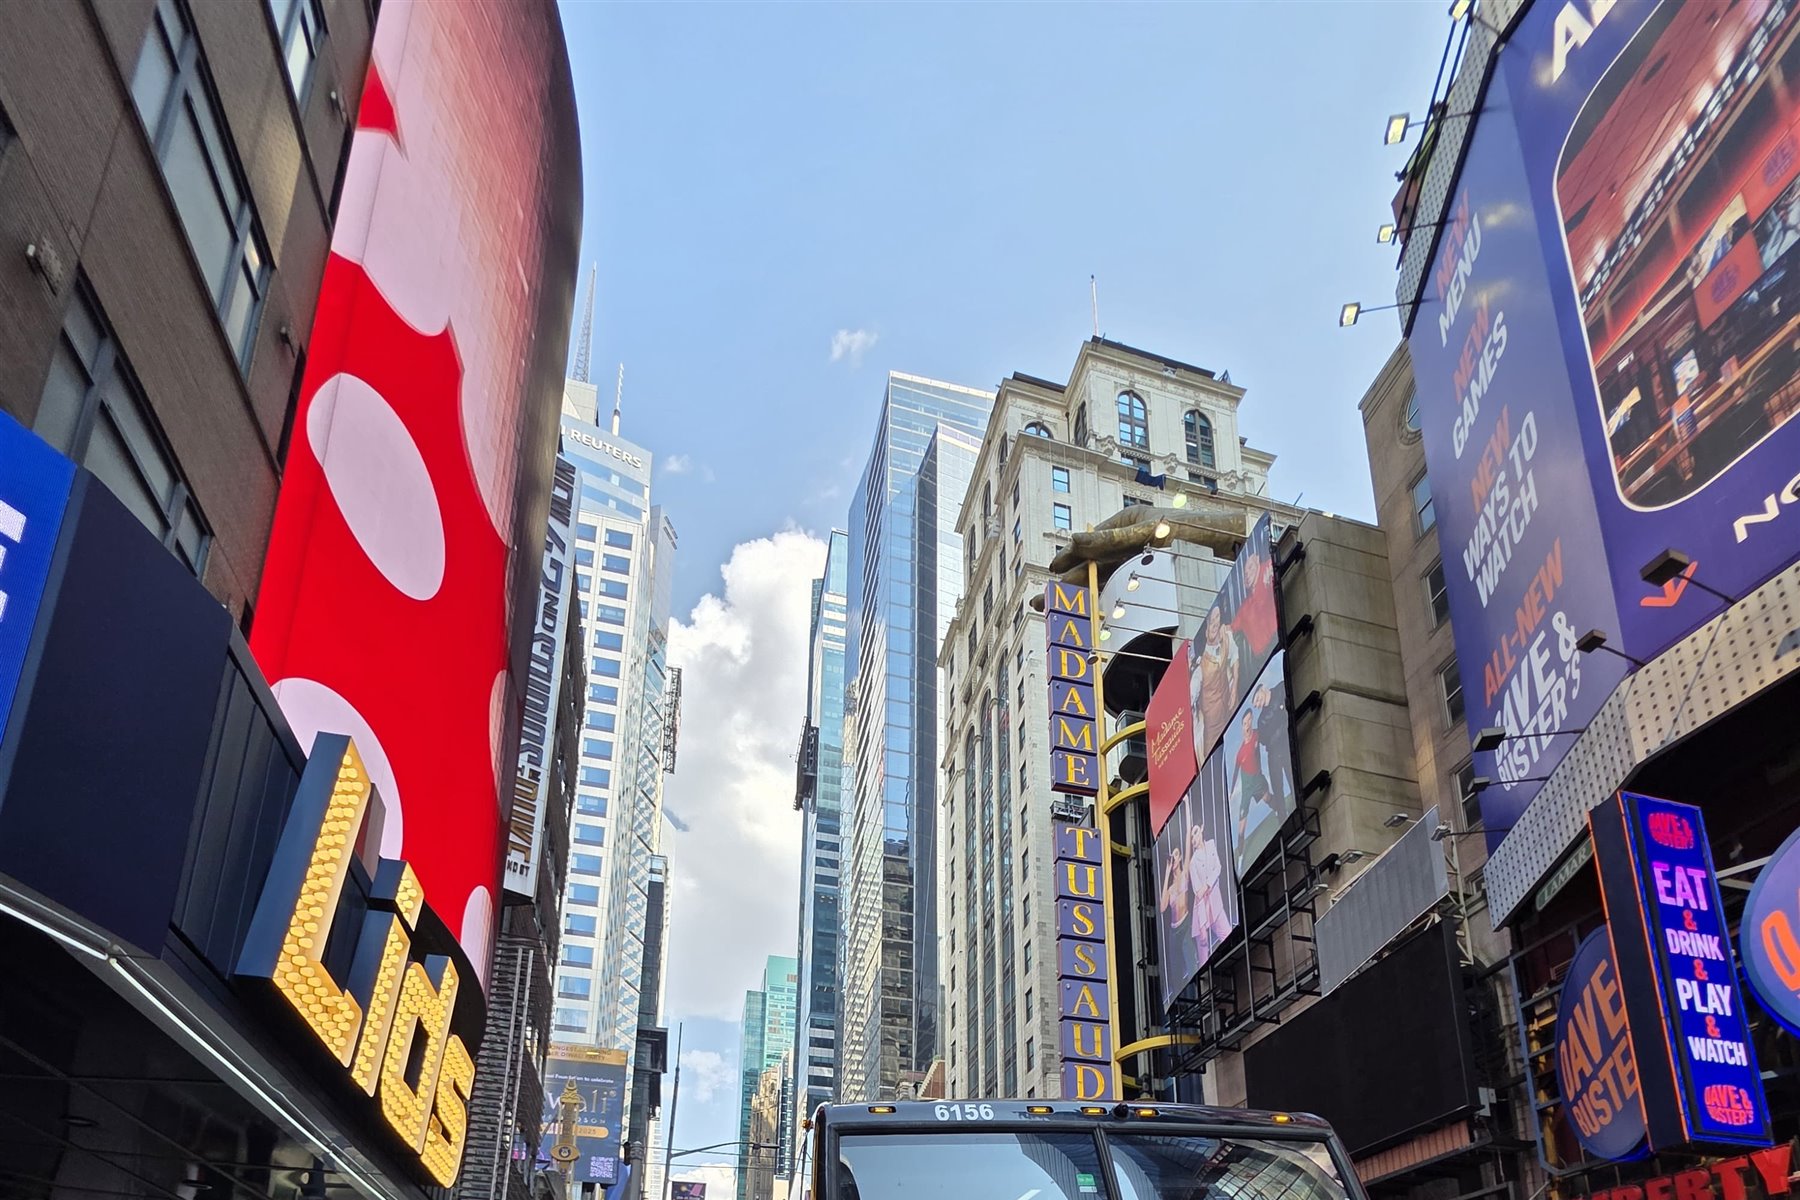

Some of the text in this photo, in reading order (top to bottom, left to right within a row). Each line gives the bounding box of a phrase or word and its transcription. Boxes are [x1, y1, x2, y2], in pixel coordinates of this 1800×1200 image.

[1436, 187, 1470, 300] NEW
[1439, 212, 1482, 348] MENU
[1454, 299, 1490, 404] NEW
[1452, 311, 1508, 460] GAMES
[570, 428, 642, 469] REUTERS
[1471, 403, 1511, 514] NEW
[1463, 411, 1539, 582] WAYS TO
[1475, 468, 1539, 609] WATCH
[1484, 536, 1564, 708] ALL-NEW
[1552, 610, 1578, 663] &
[1053, 583, 1094, 786] MADAME
[1151, 706, 1185, 756] Madame
[1152, 720, 1185, 766] Tussauds
[1544, 847, 1587, 901] LAMAR
[1652, 861, 1708, 911] EAT
[1665, 927, 1725, 962] DRINK
[1683, 909, 1698, 931] &
[1063, 826, 1107, 1101] TUSSAUD
[1693, 959, 1709, 981] &
[1675, 977, 1732, 1017] PLAY
[1559, 958, 1627, 1103] DAVE
[1687, 1036, 1748, 1067] WATCH
[1705, 1015, 1721, 1039] &
[934, 1103, 995, 1121] 6156
